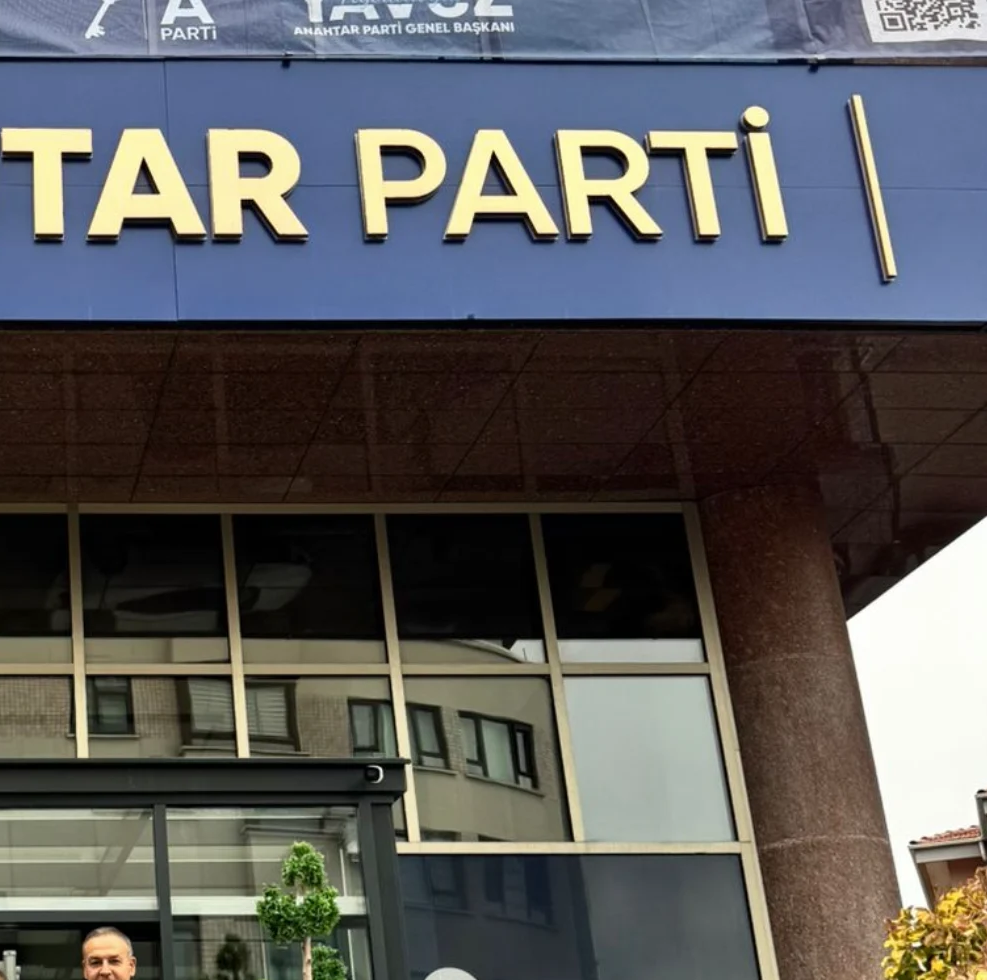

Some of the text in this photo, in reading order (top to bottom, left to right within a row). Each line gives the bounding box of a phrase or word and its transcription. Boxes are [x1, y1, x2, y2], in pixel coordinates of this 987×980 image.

[294, 25, 363, 36] ANAHTAR
[405, 22, 451, 34] GENEL
[454, 21, 515, 36] BAŞKANI
[355, 105, 789, 242] PARTİ
